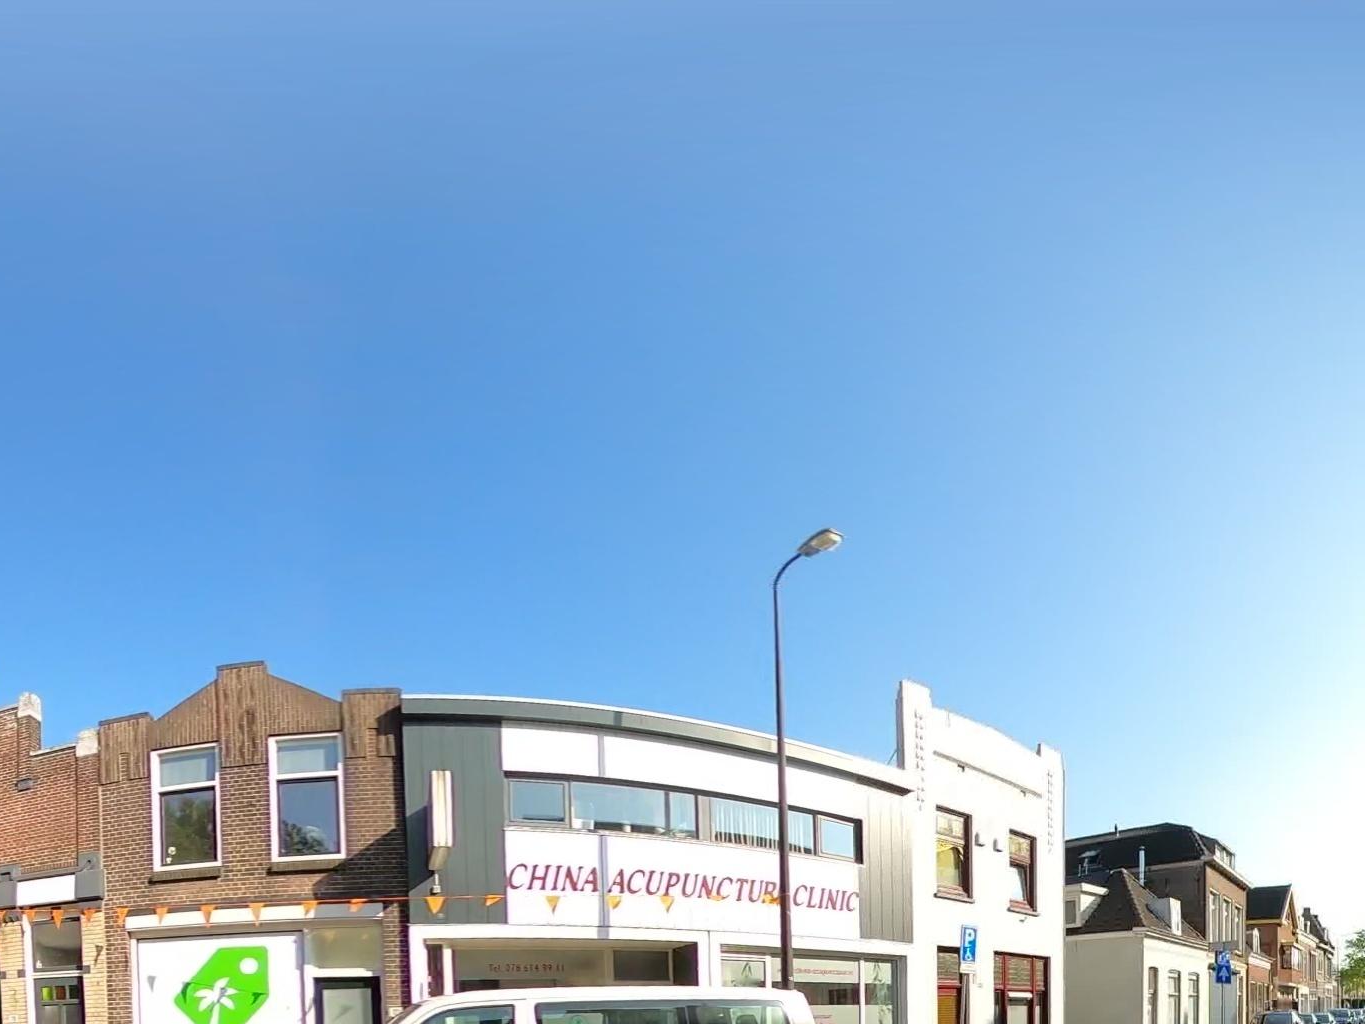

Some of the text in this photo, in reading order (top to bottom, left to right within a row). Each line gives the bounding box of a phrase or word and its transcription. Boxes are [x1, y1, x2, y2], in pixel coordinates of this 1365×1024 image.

[505, 862, 860, 912] CHINA ACUPUNCTUR CLINIC
